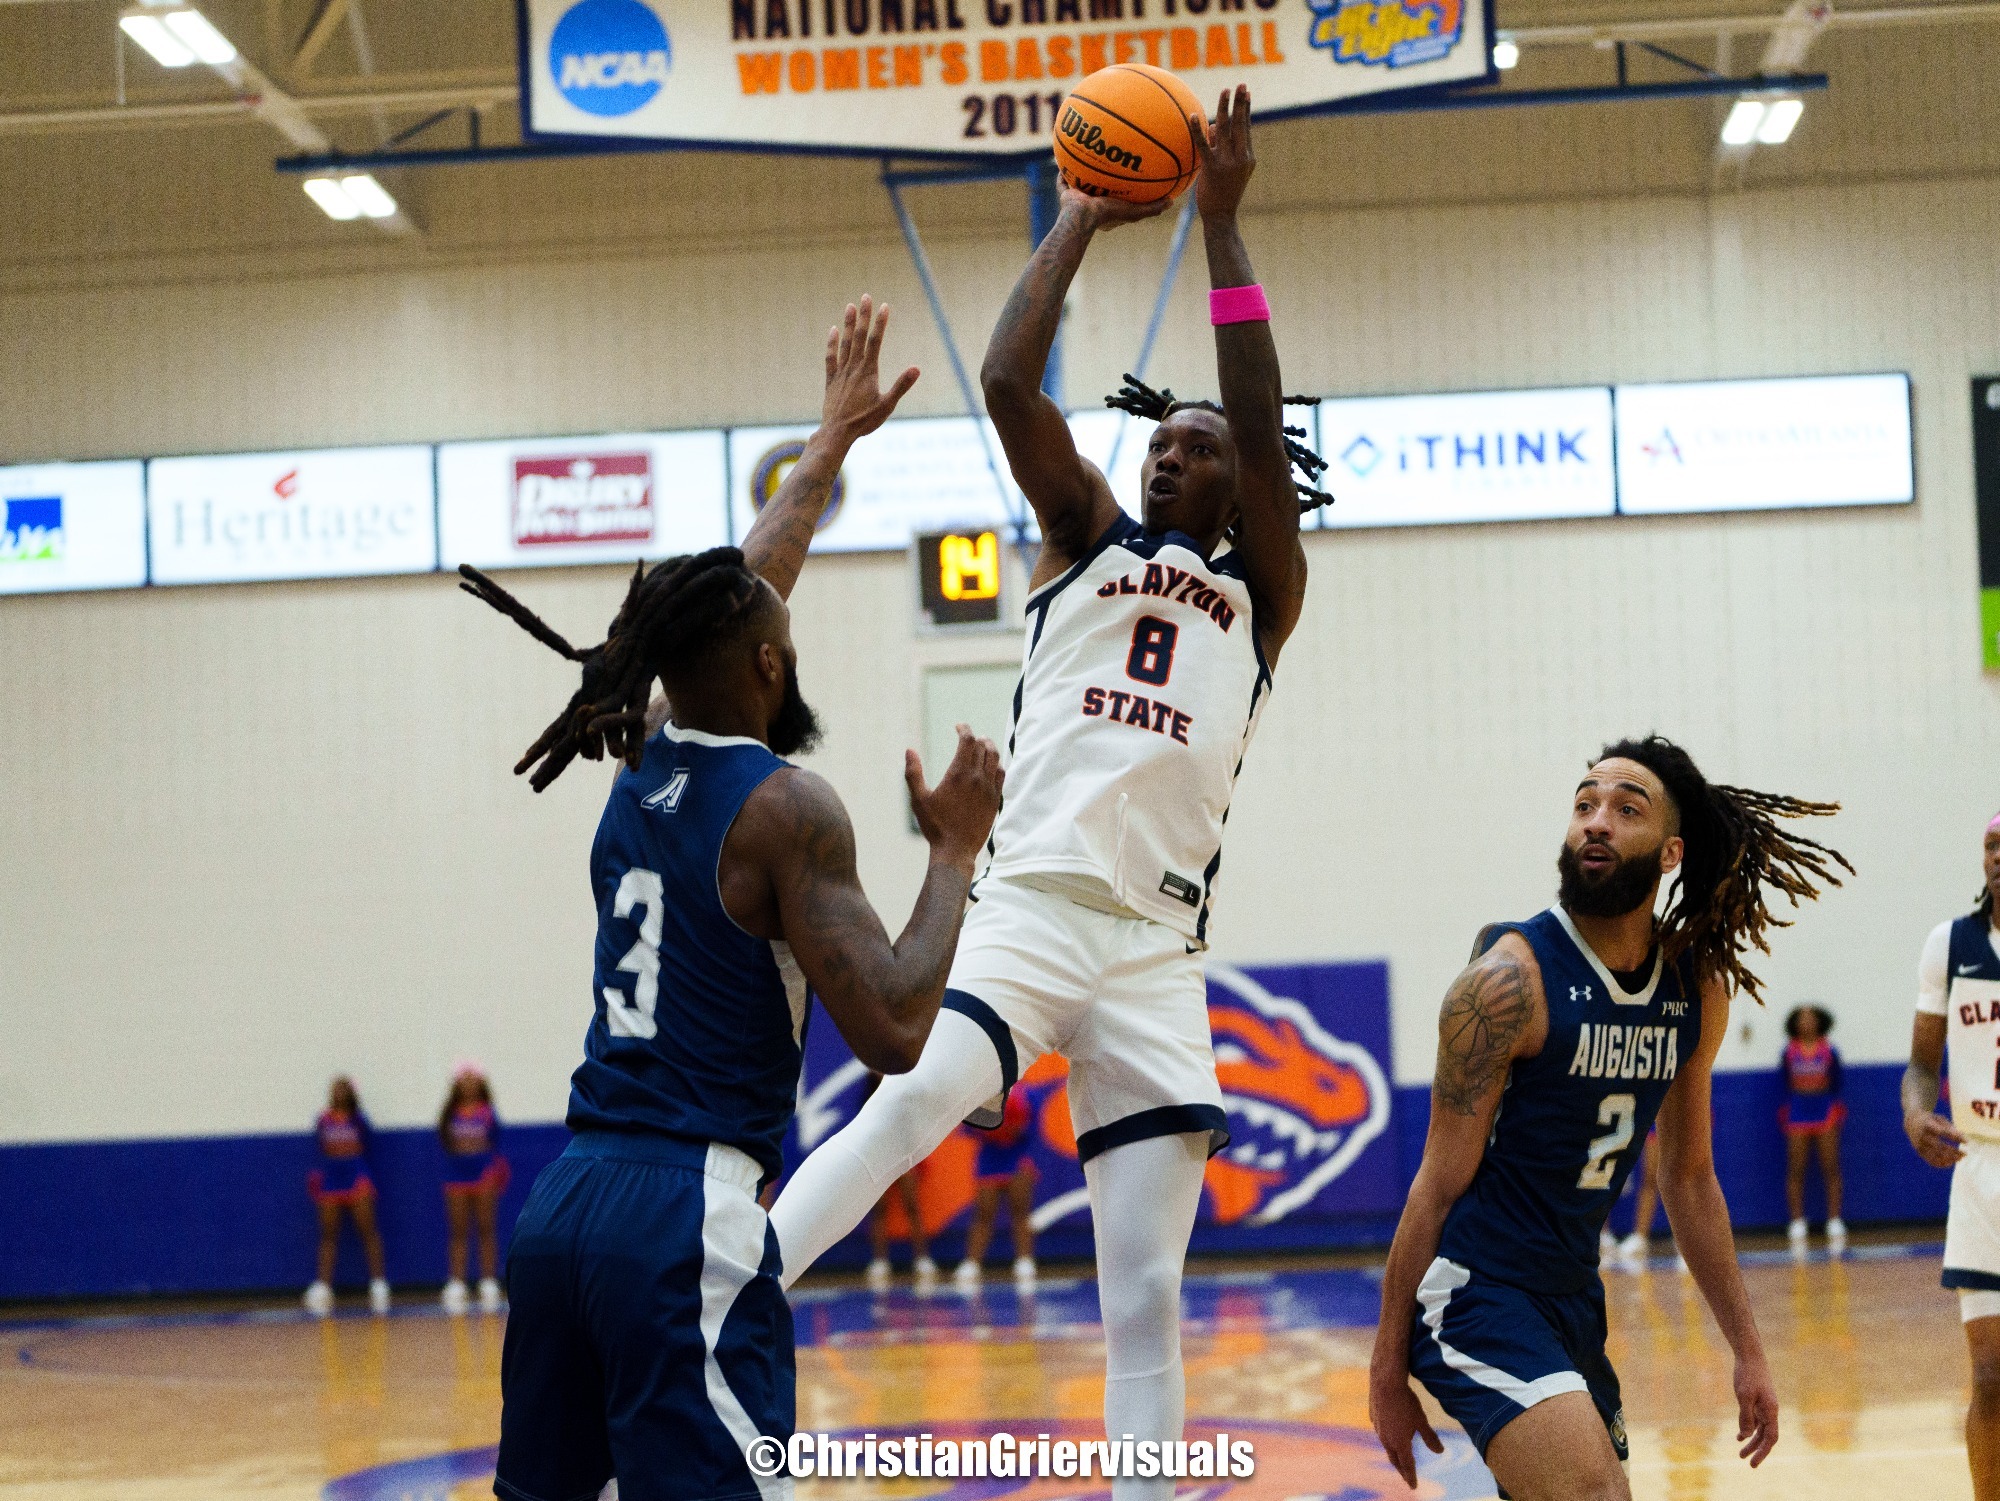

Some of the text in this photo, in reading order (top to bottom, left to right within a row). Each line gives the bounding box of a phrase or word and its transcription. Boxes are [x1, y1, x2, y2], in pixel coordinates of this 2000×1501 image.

[561, 50, 669, 89] NCAA
[736, 41, 969, 95] WOMEN'S
[979, 20, 1284, 83] BASKETBALL
[1061, 106, 1142, 172] Wilson
[1398, 429, 1587, 471] iTHINK
[172, 498, 415, 554] Heritage
[1125, 614, 1179, 687] 8
[1083, 686, 1193, 746] STATE
[602, 866, 664, 1040] 3
[1568, 1022, 1678, 1080] AUGUSTA
[1576, 1093, 1636, 1189] 2
